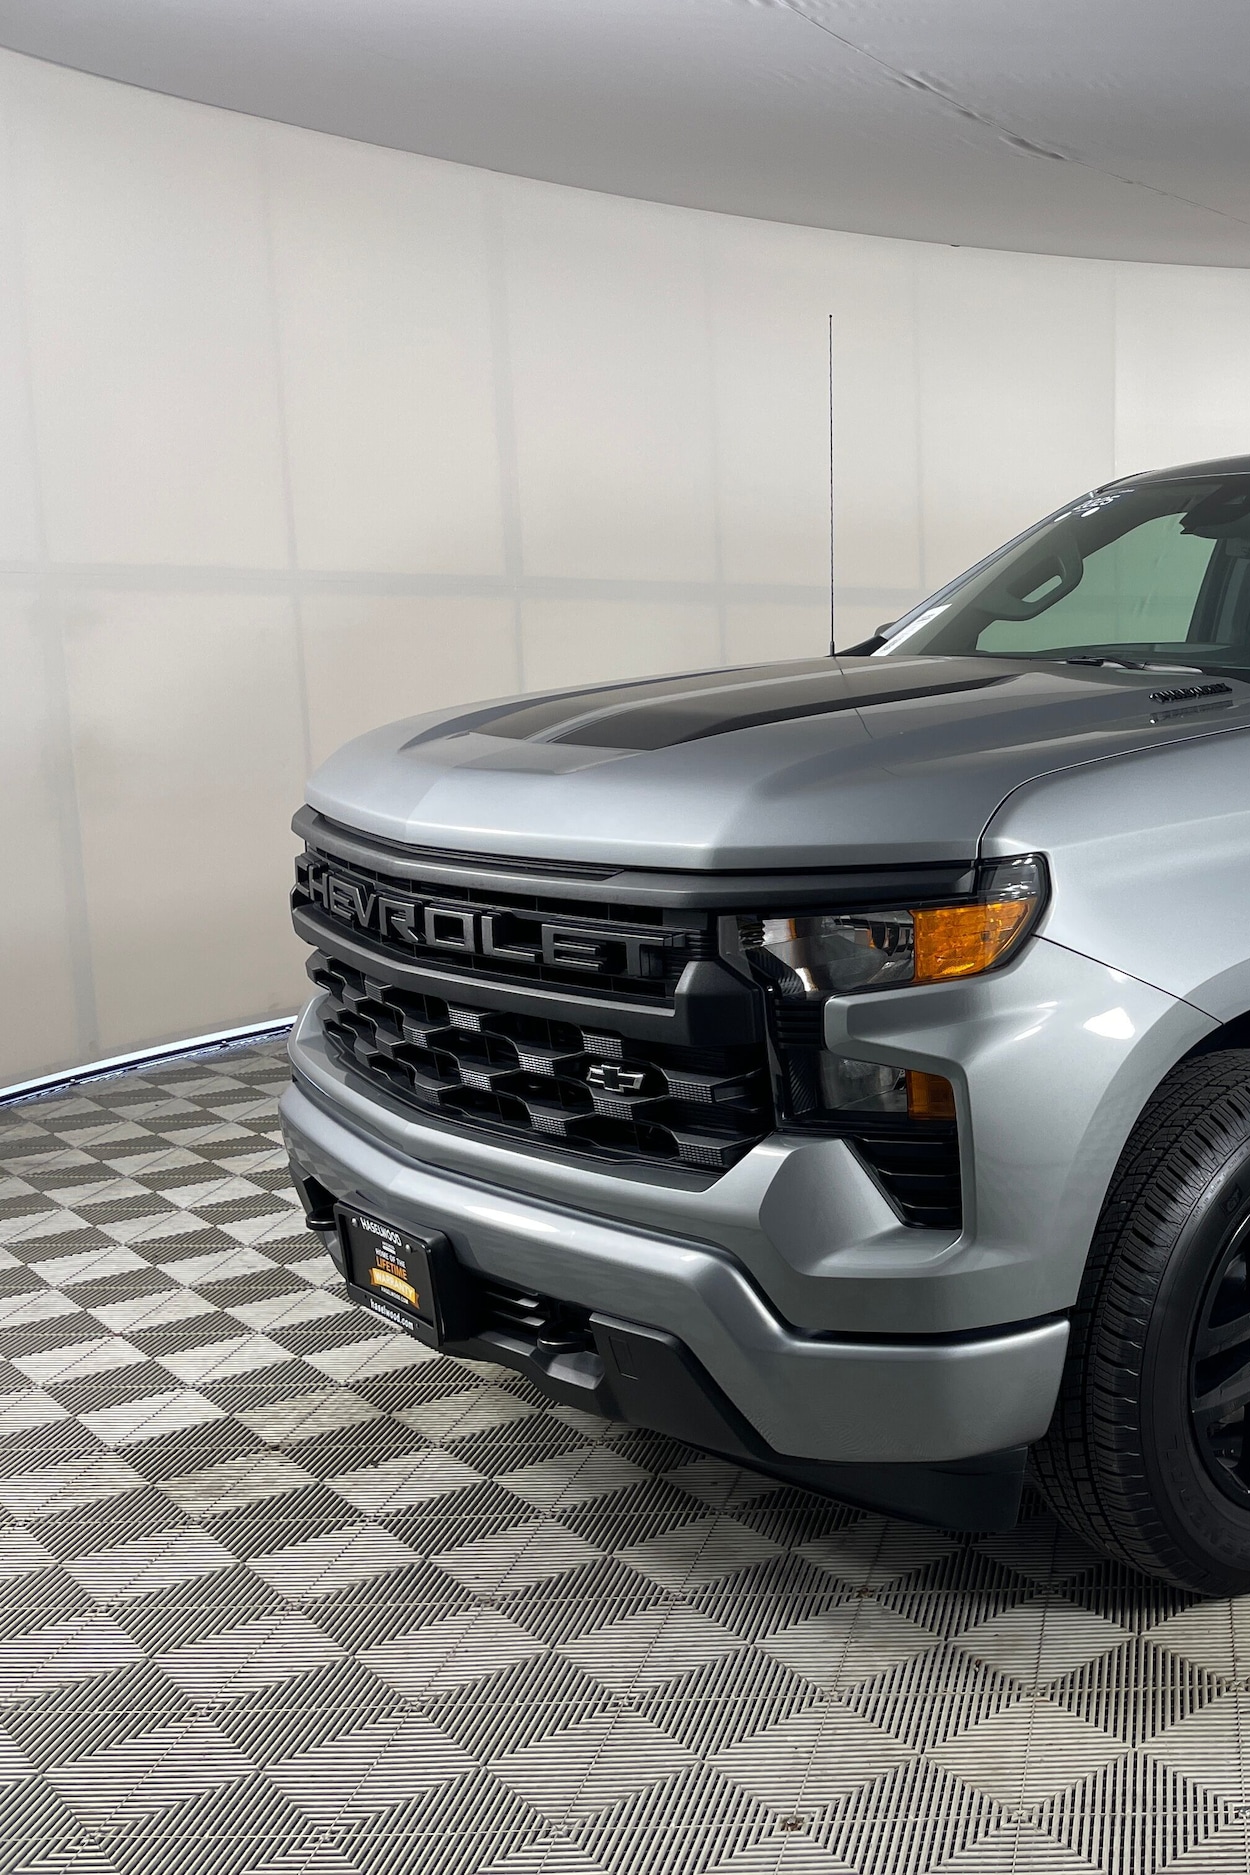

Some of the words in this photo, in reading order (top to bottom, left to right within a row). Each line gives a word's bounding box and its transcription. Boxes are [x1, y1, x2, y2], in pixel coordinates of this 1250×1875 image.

[293, 853, 688, 978] CHEVROLET
[360, 1217, 402, 1246] HASELWOOD
[375, 1248, 390, 1260] HOME
[396, 1257, 406, 1268] THE
[376, 1255, 408, 1281] LIFETIME
[375, 1271, 413, 1297] WARRANTY
[370, 1299, 414, 1330] haselwood.com
